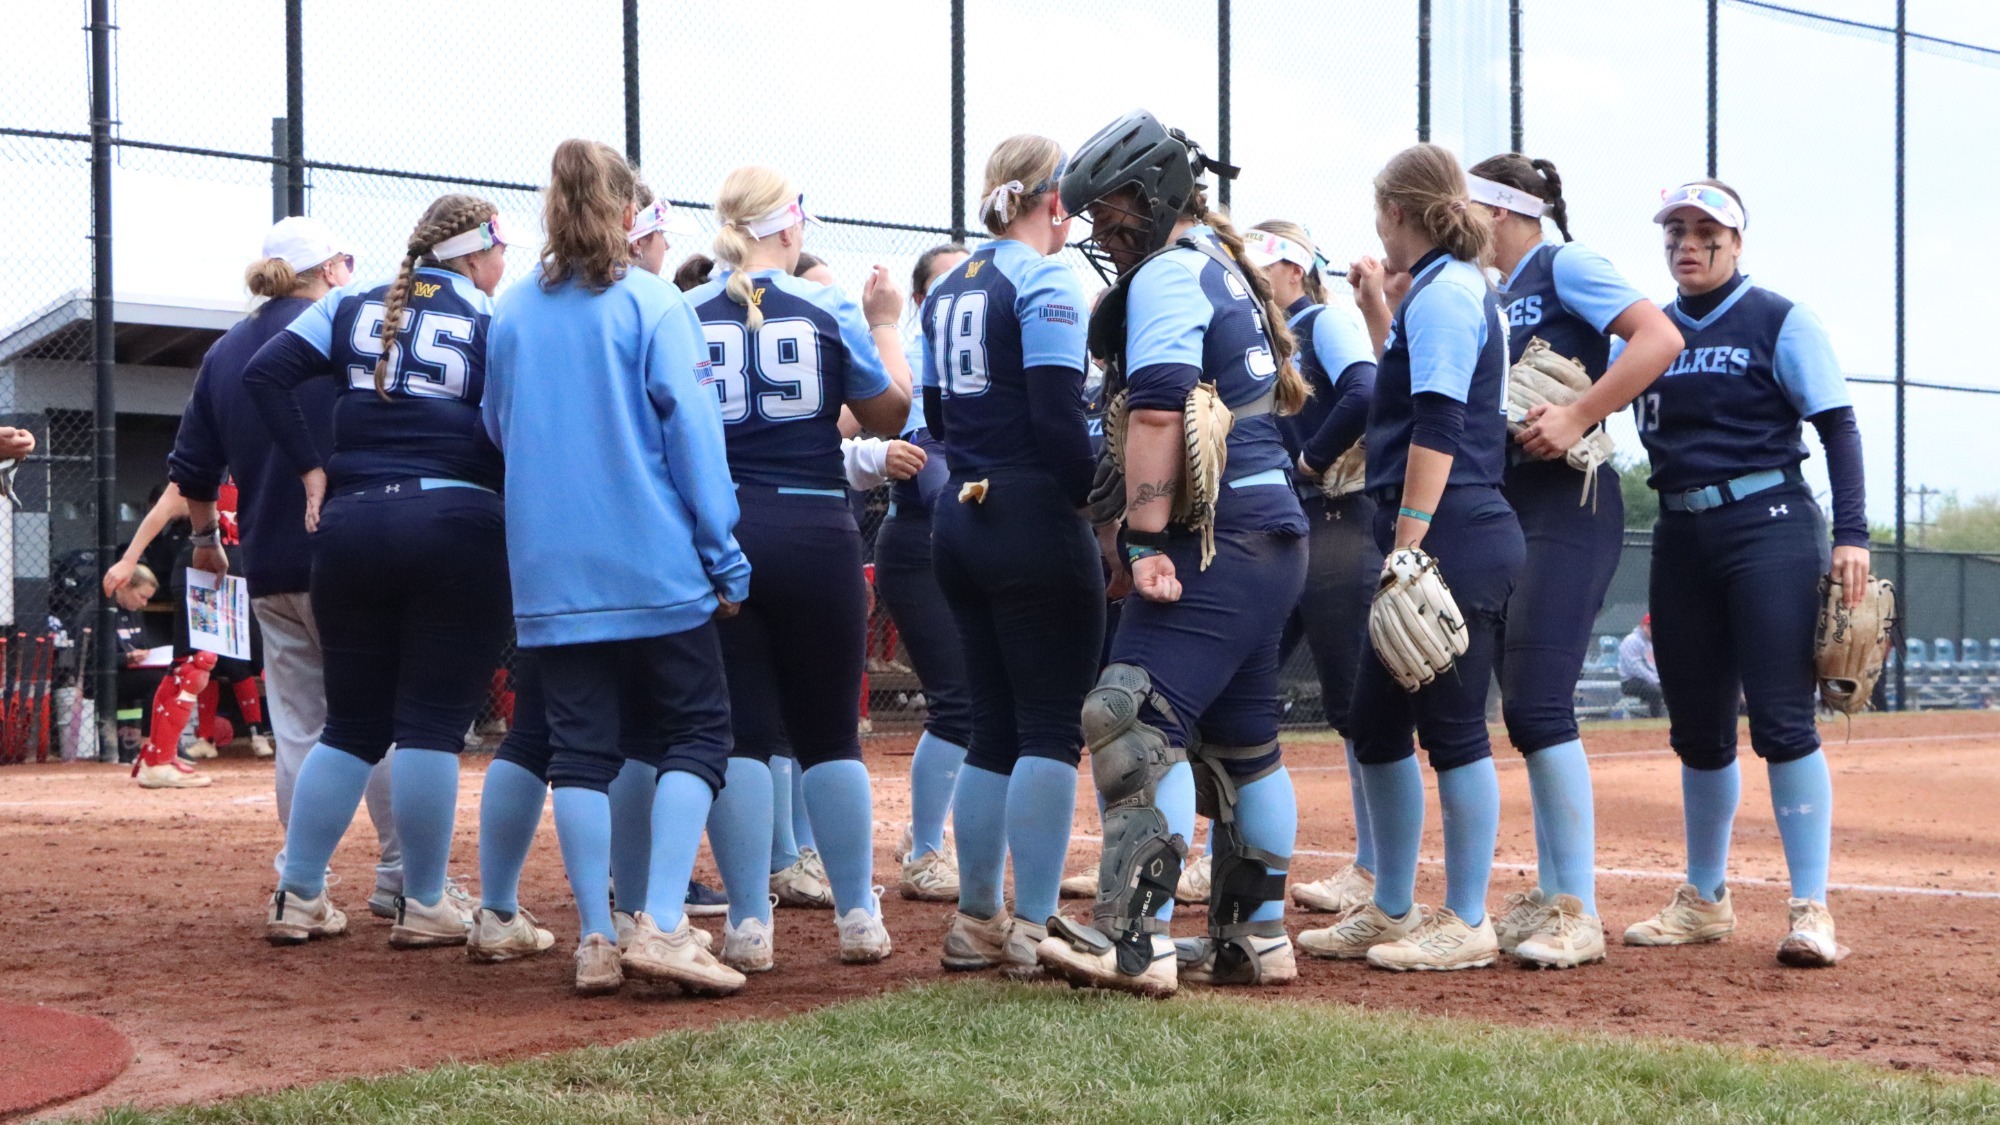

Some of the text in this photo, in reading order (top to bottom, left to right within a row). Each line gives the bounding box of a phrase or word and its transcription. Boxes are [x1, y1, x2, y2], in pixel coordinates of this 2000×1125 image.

[415, 282, 441, 297] W
[347, 300, 475, 399] 55
[932, 289, 991, 398] 18
[1664, 346, 1751, 377] ILKES
[1637, 393, 1660, 431] 13
